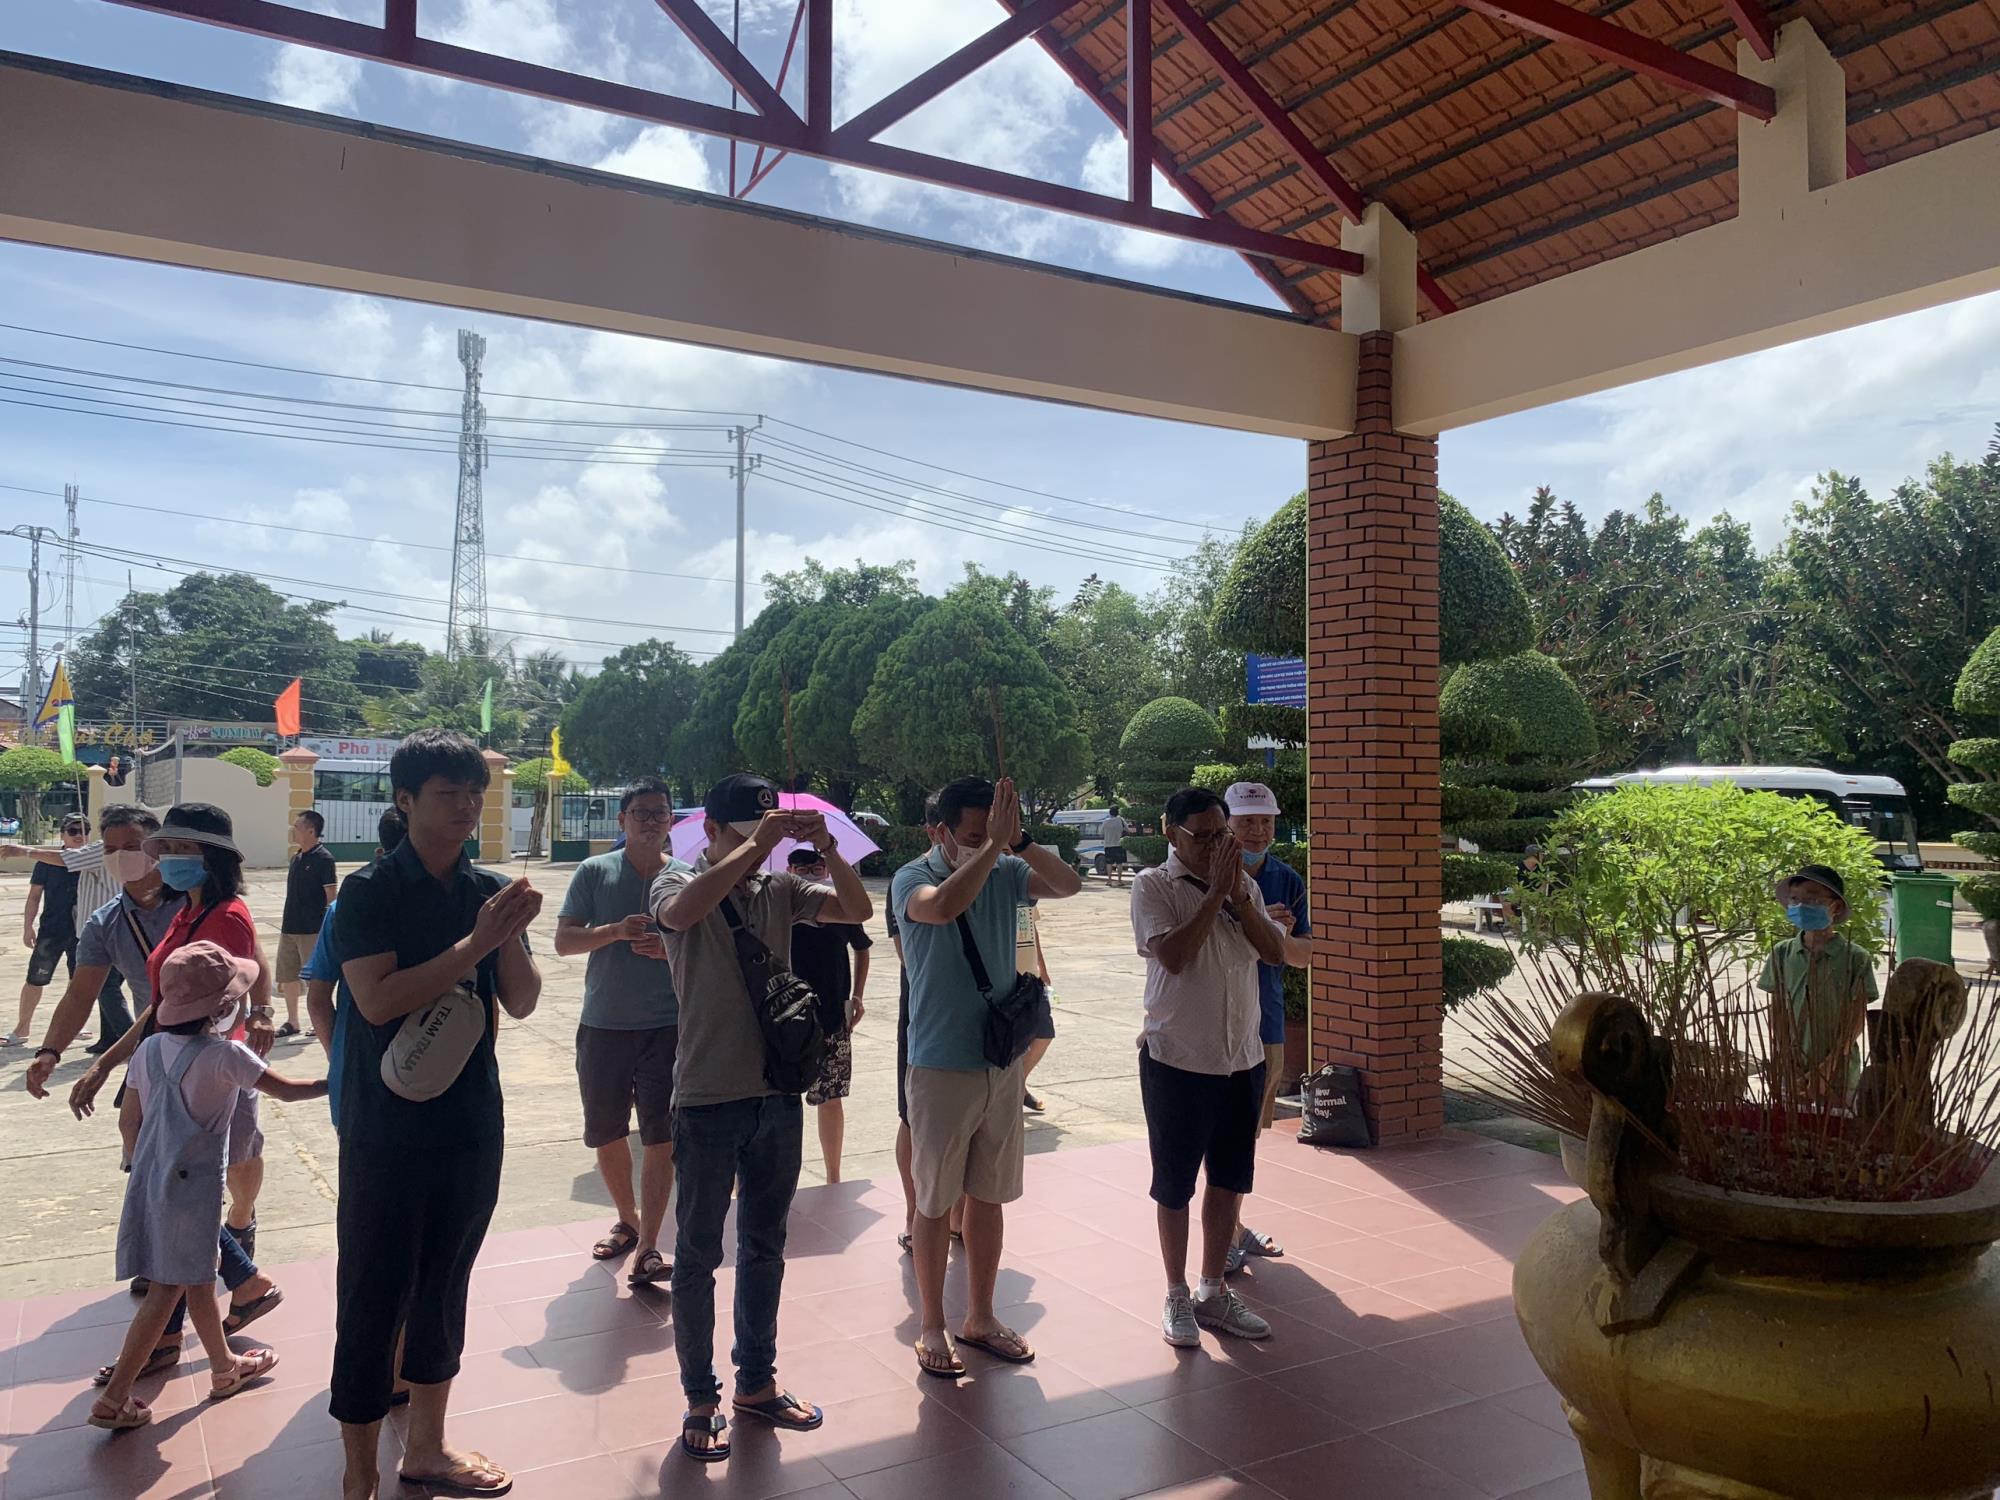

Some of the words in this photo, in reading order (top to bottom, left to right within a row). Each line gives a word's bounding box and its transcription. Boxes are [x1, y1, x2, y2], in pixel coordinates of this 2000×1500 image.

[183, 725, 209, 739] offee
[425, 1006, 453, 1037] TEAM
[1314, 1096, 1347, 1106] Normal
